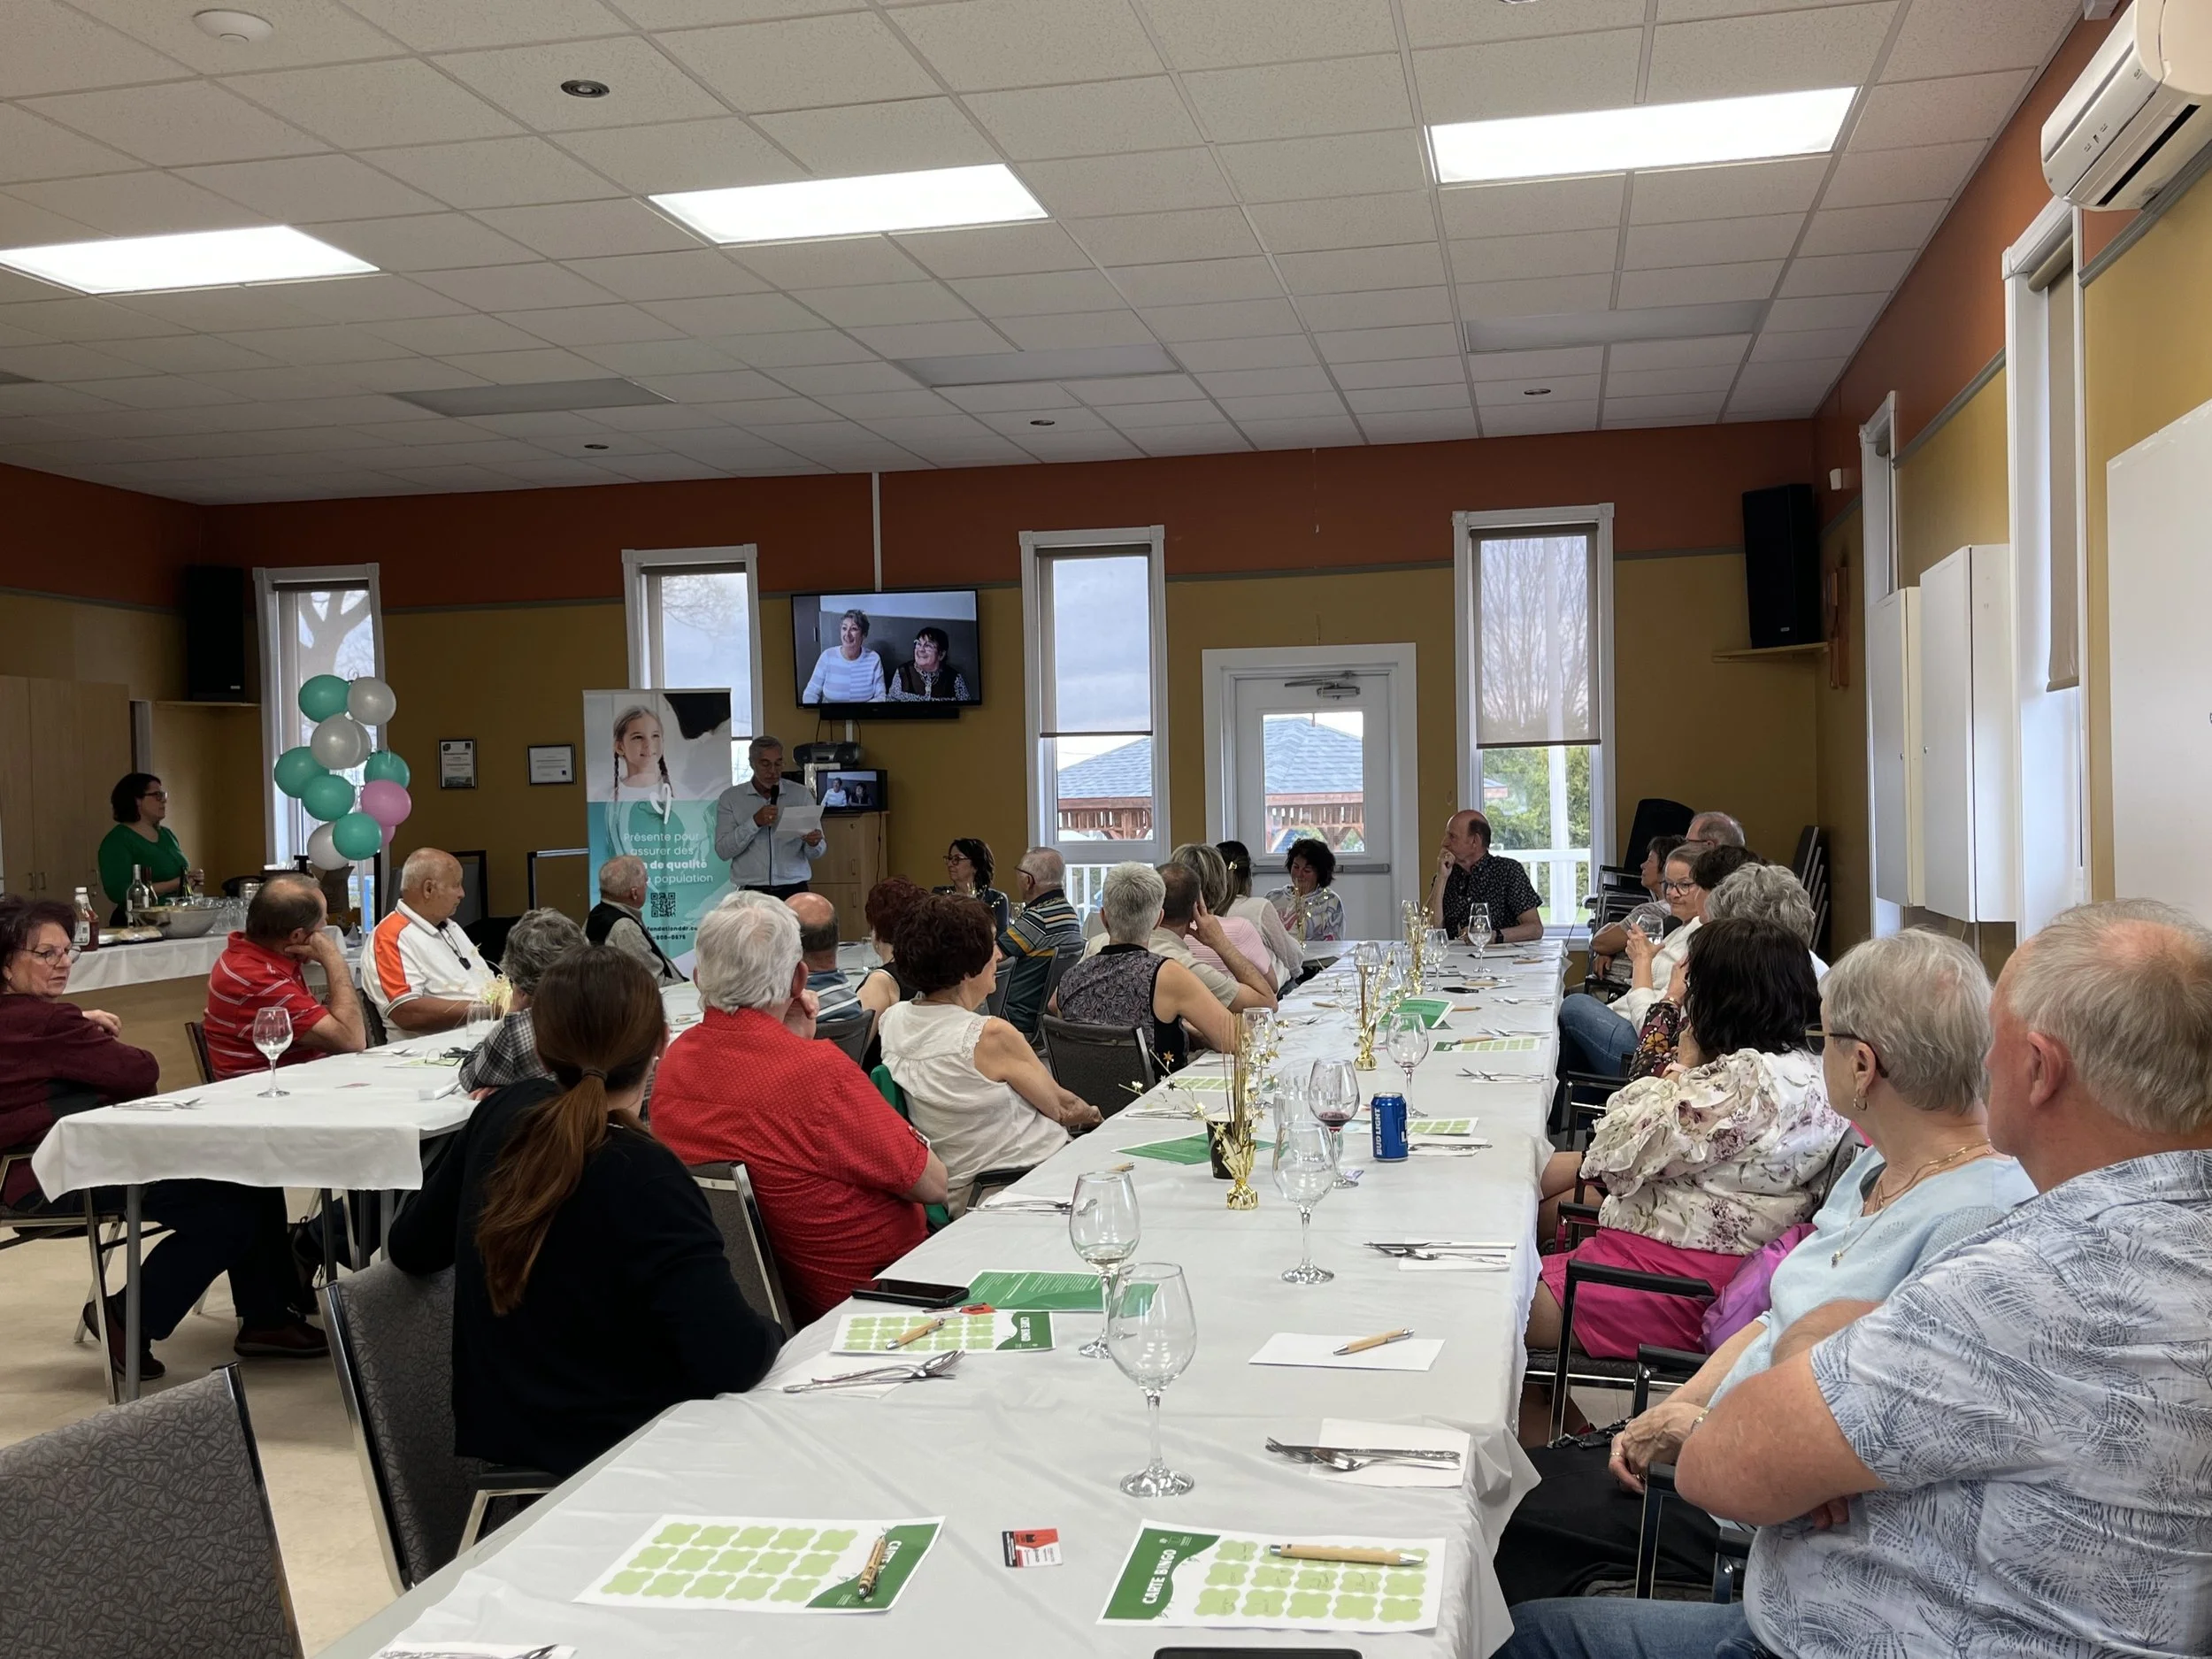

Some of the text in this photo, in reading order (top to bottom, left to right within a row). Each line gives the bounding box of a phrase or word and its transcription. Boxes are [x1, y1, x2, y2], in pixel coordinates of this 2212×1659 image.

[624, 833, 700, 843] Présente pour
[674, 847, 694, 856] des
[650, 860, 664, 870] de
[666, 859, 708, 872] qualité
[655, 874, 713, 886] population
[1142, 1548, 1177, 1604] CARTE BINGO
